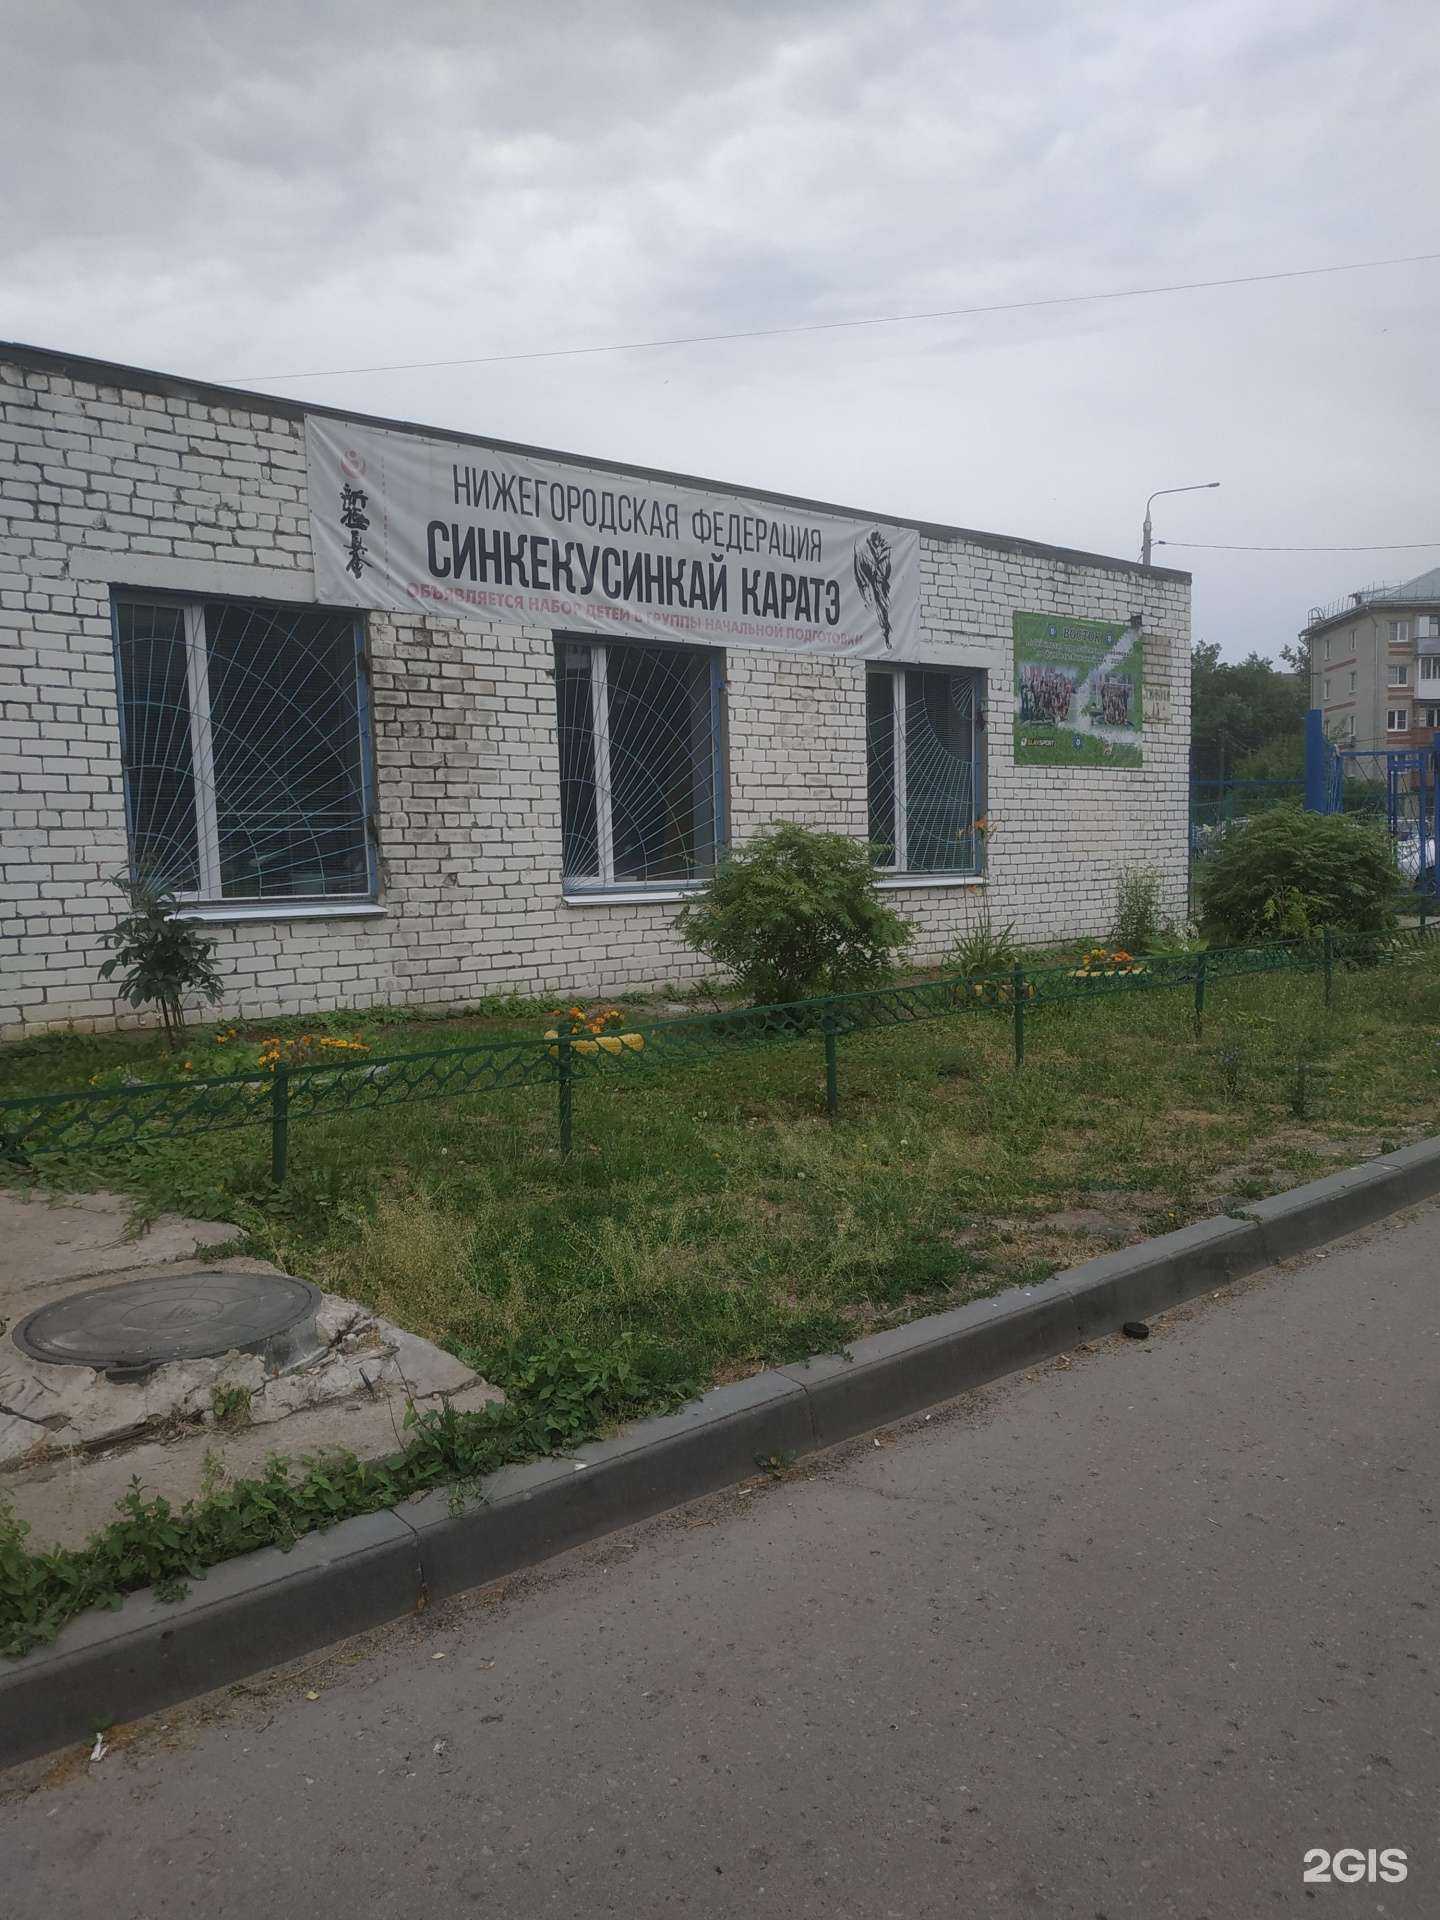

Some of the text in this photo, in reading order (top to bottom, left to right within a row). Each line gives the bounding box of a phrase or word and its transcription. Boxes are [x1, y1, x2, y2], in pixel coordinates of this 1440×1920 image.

[453, 464, 679, 540] НИЖЕГОРОДСКАЯ
[692, 509, 822, 562] ФЕДЕРАЦИЯ
[427, 520, 727, 612] СИНКЕКУСИНКАЙ
[742, 567, 840, 626] КАРАТЭ
[705, 618, 783, 638] НАЧАЛЬНОЙ
[786, 628, 864, 646] ПОДГОТОВКИ
